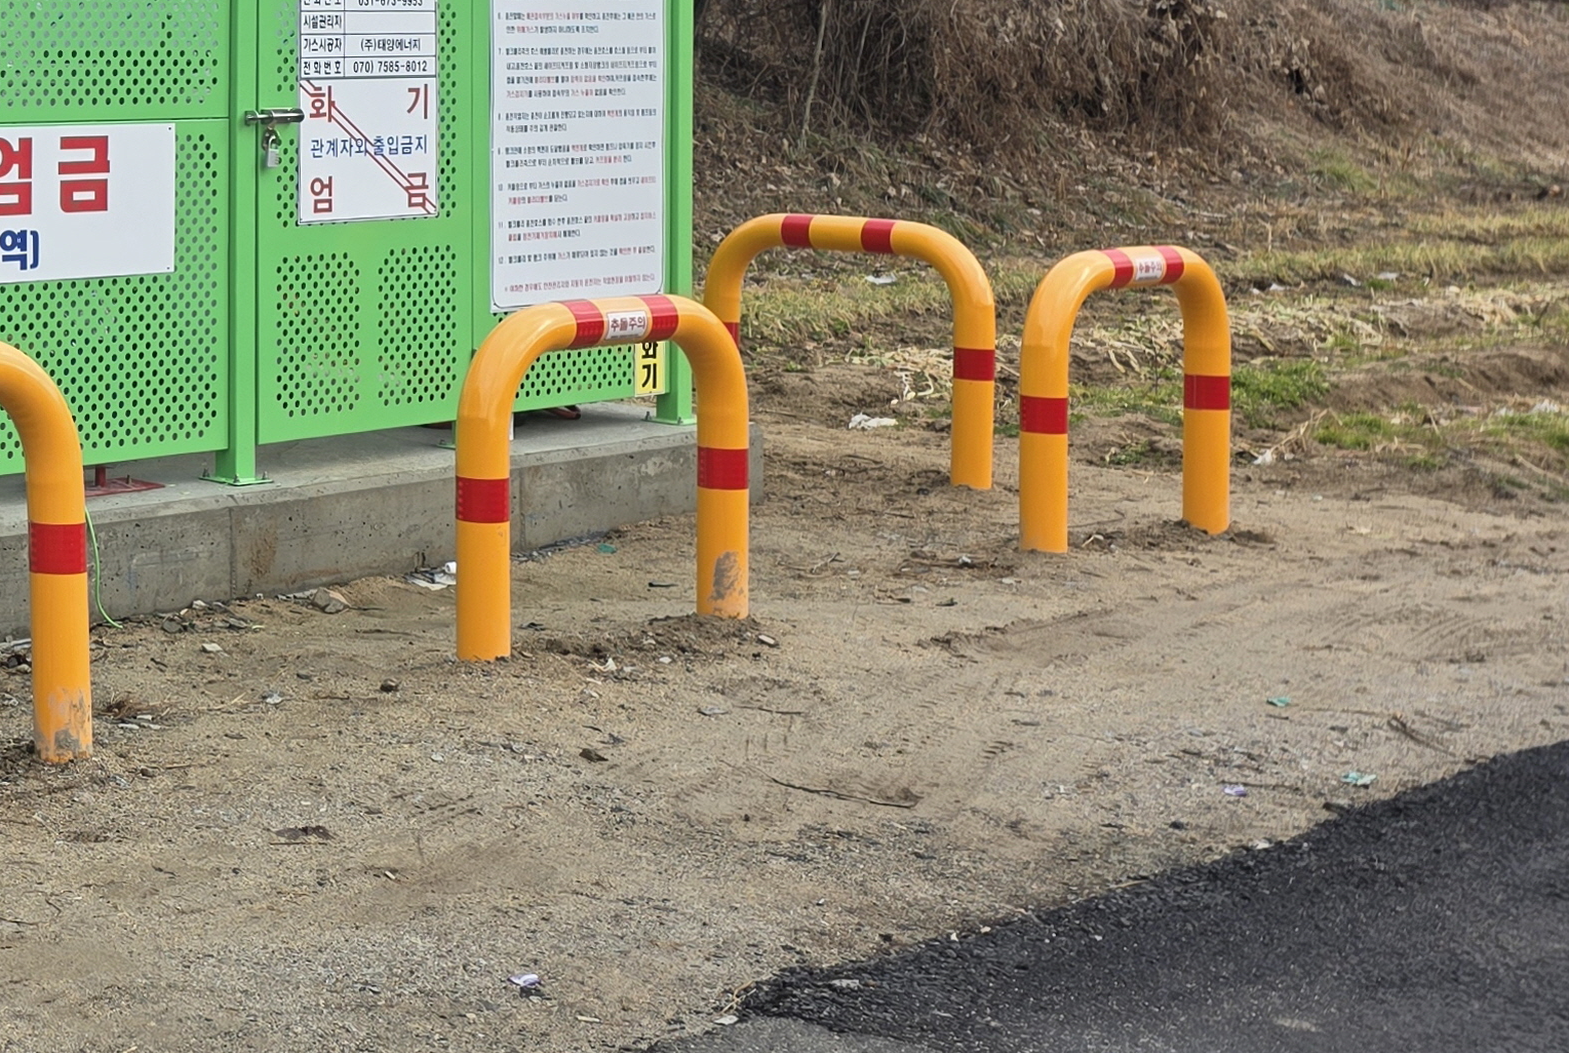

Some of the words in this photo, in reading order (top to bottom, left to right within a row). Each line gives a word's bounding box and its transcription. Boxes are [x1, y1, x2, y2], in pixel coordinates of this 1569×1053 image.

[303, 14, 342, 29] 시설관리자
[303, 37, 342, 52] 가스시공자
[353, 60, 374, 73] 070)
[377, 60, 427, 73] 7585-8012
[310, 137, 368, 159] 관계자외
[372, 134, 427, 156] 출입금지
